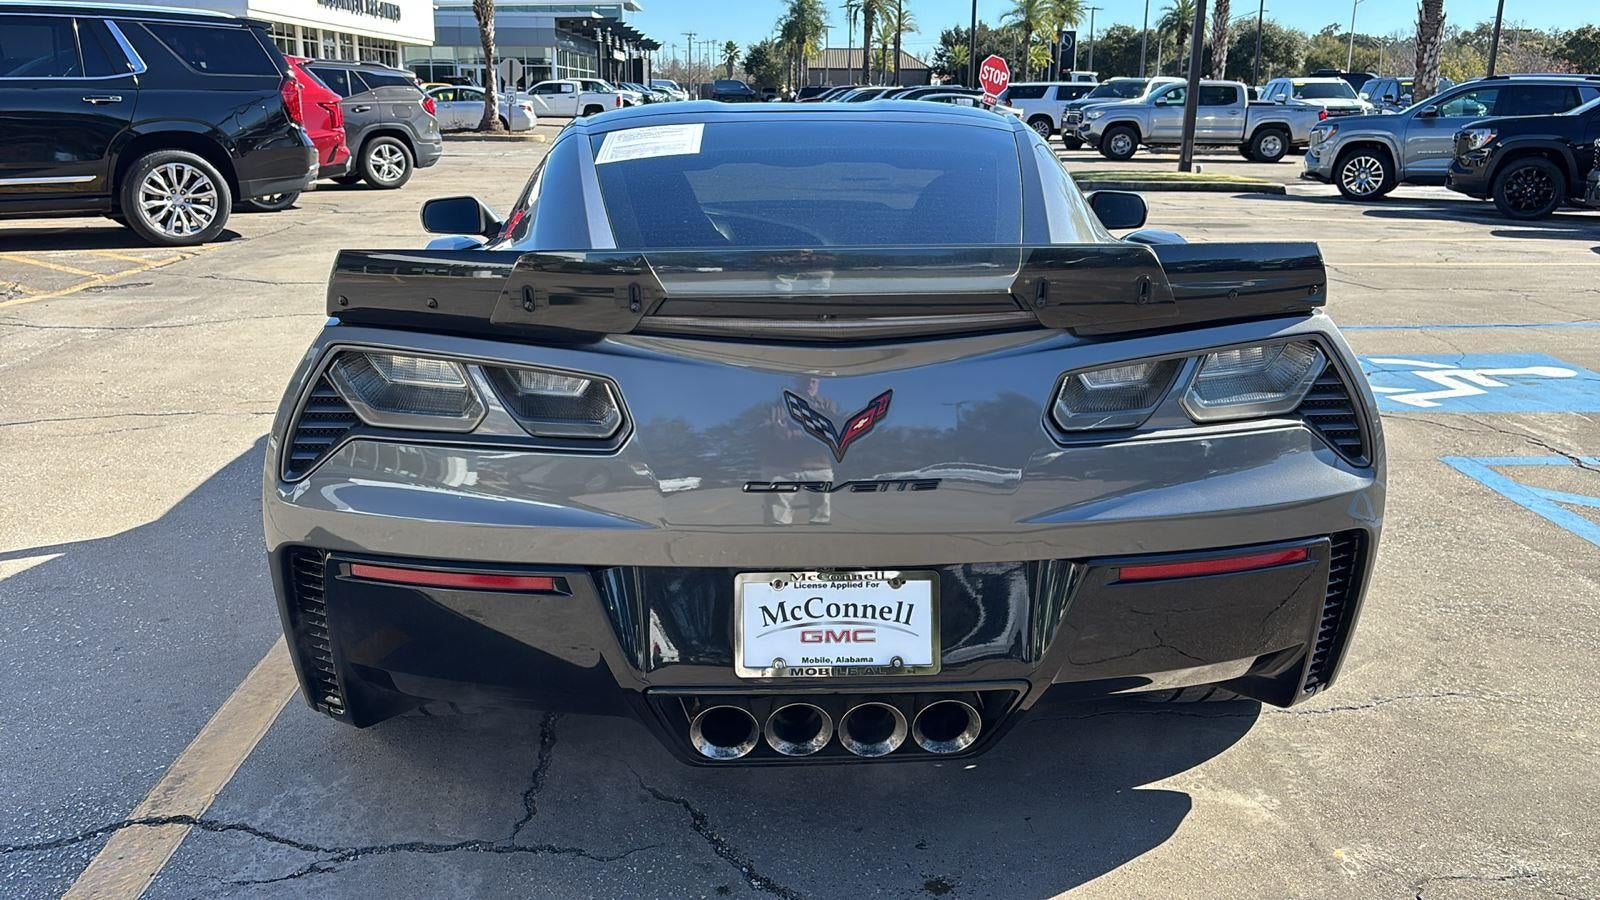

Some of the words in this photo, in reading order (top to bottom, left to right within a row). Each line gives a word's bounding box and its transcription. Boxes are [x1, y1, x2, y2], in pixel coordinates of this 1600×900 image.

[982, 65, 1007, 86] STOP
[743, 478, 942, 493] CORVETTE
[789, 567, 886, 581] McConnell
[794, 581, 828, 589] License
[830, 581, 863, 591] Applied
[865, 581, 880, 589] For
[758, 596, 915, 628] McConnell
[800, 629, 876, 644] GMC
[802, 656, 833, 665] Mobile,
[835, 656, 874, 664] Alabama
[789, 667, 857, 677] MOBILE
